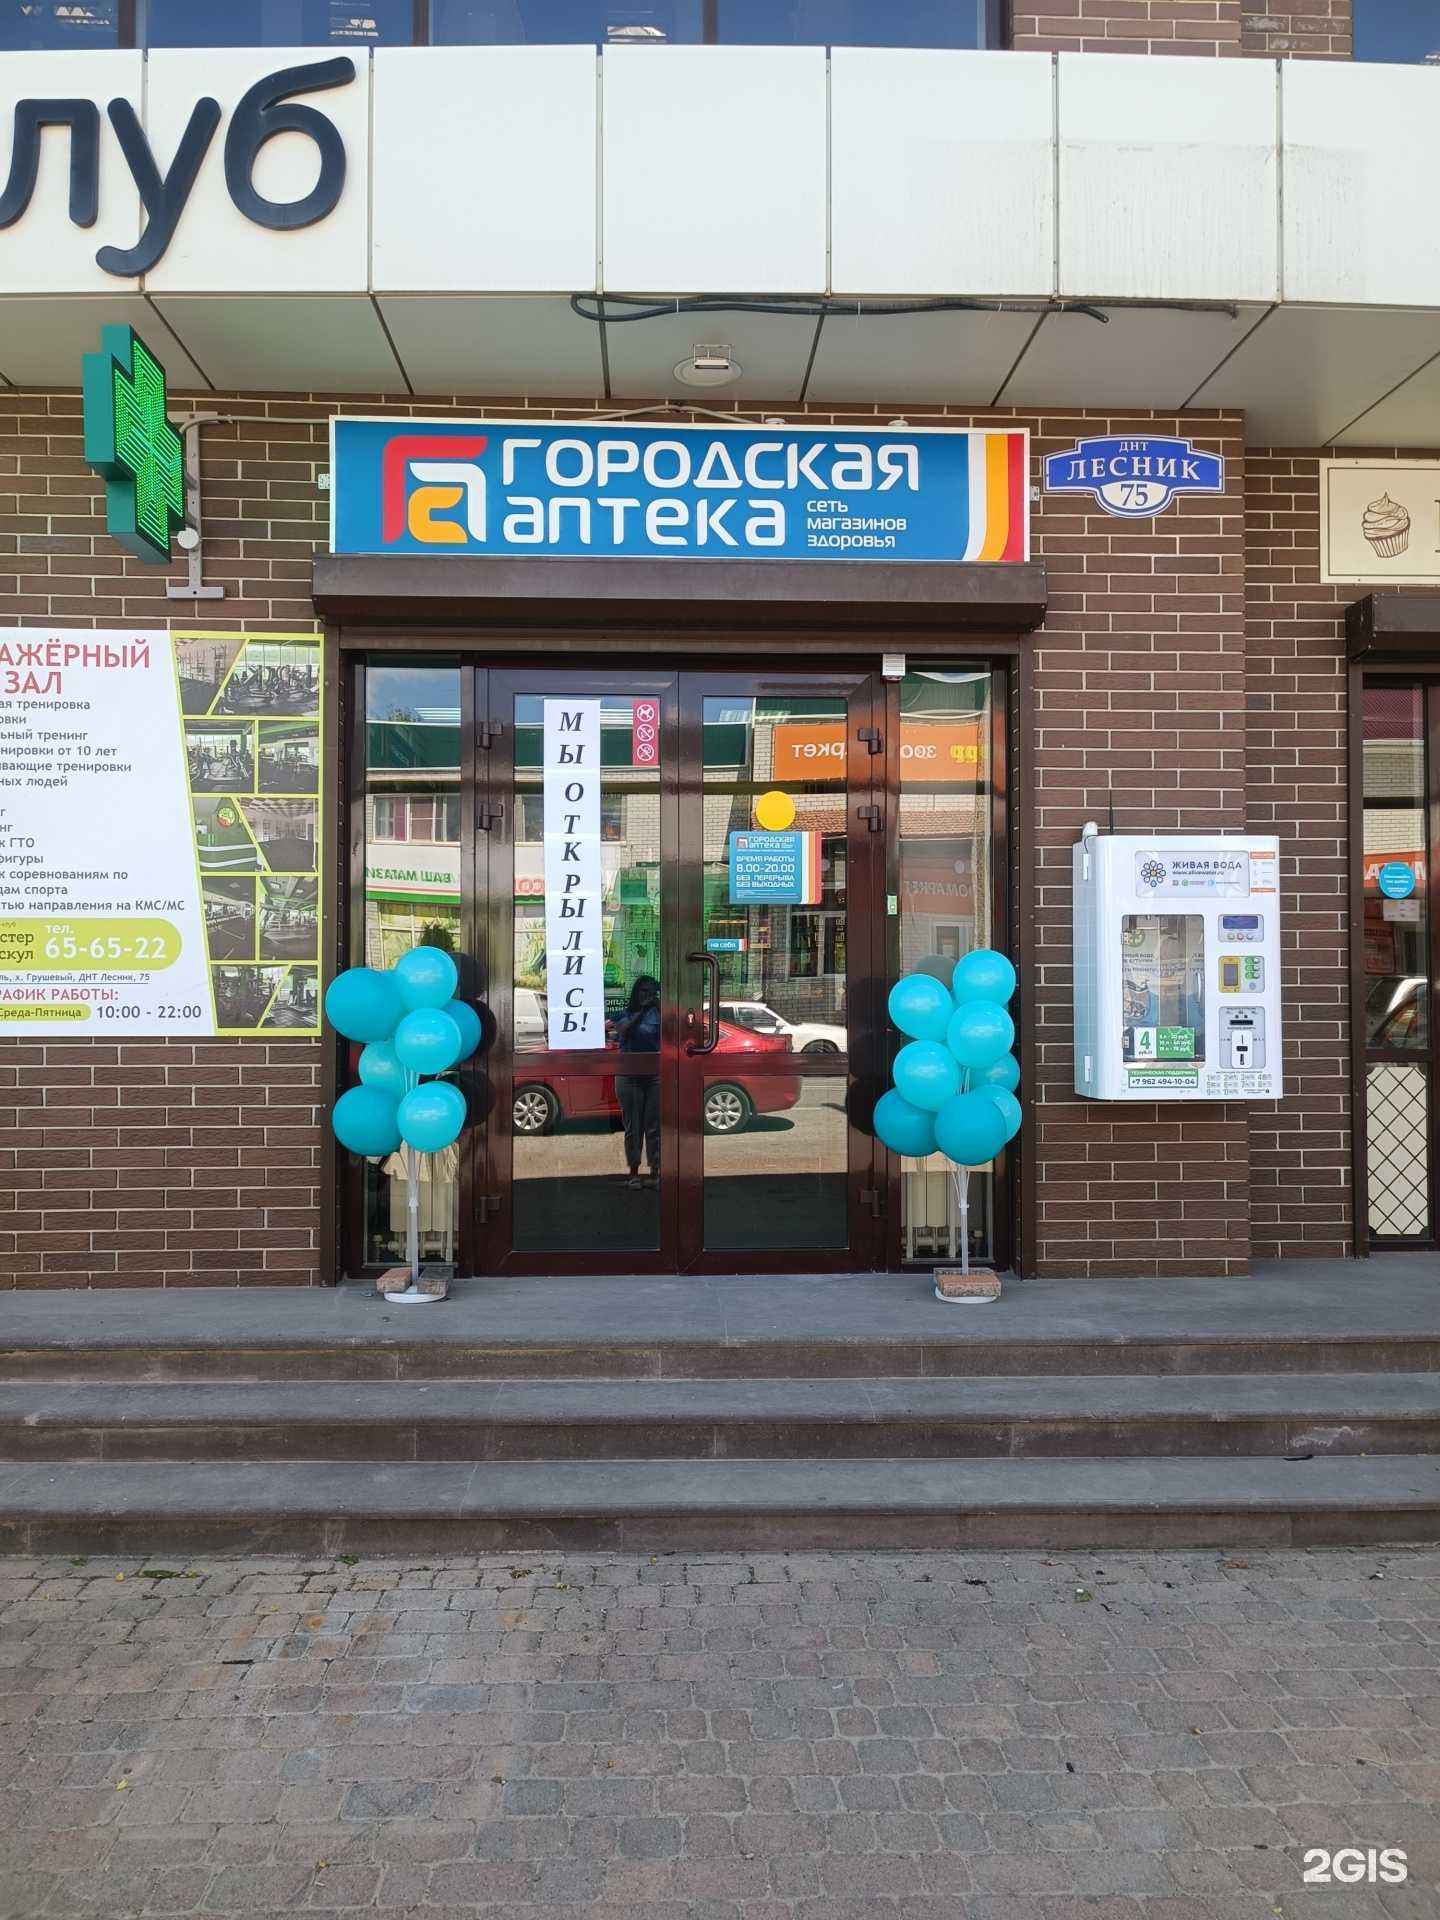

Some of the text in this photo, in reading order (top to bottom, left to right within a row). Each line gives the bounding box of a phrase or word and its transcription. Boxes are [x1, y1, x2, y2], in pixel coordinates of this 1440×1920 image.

[0, 57, 356, 277] луб
[1118, 441, 1149, 453] ДНТ
[1067, 456, 1200, 480] ЛЕСНИК
[1120, 483, 1149, 506] 75
[807, 500, 848, 513] сеть
[807, 516, 907, 531] магазинов
[807, 534, 895, 550] здоровья
[5, 671, 62, 694] ЗАЛ
[17, 700, 91, 711] тренировка
[38, 731, 88, 742] тренинг
[1, 746, 117, 758] нировки от 10 лет
[0, 762, 131, 773] вающие тренировки
[26, 777, 68, 788] людей
[10, 837, 35, 848] ГТО
[736, 864, 795, 873] 8.00-20.00
[1172, 861, 1242, 870] ЖИВАЯ ВОДА
[9, 870, 109, 881] соревнованиям
[113, 872, 128, 880] по
[24, 886, 68, 897] спорта
[29, 902, 112, 912] направления
[117, 902, 131, 911] на
[135, 900, 185, 911] КМС/МС
[45, 925, 74, 934] тел.
[0, 933, 34, 946] стер
[45, 937, 167, 959] 65-65-22
[79, 973, 97, 982] ДНТ
[139, 973, 150, 981] 75
[0, 988, 119, 1001] АФИК РАБОТЫ:
[97, 1005, 141, 1019] 10:00
[157, 1005, 202, 1019] 22:00
[1140, 1031, 1151, 1050] 4
